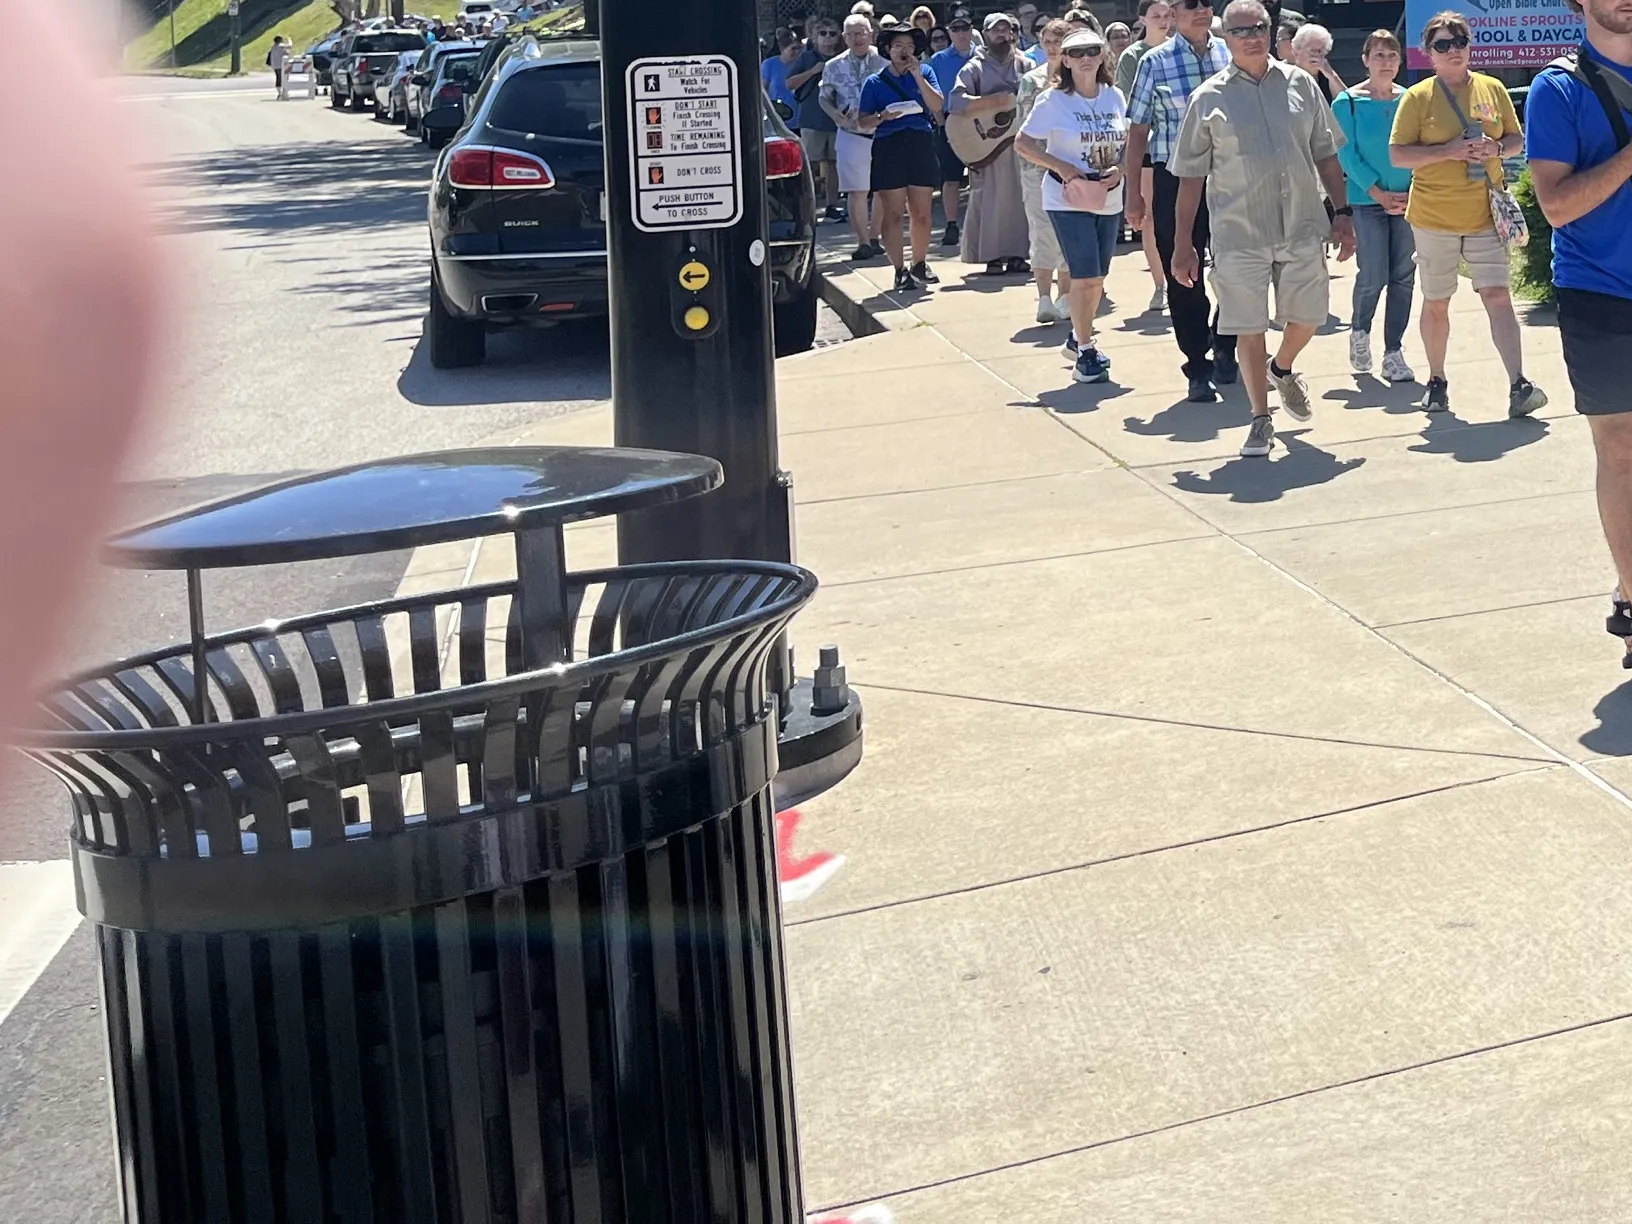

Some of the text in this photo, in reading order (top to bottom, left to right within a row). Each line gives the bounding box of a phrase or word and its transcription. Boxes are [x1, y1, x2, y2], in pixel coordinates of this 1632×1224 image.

[1468, 14, 1583, 28] OKLINE SPROUTS
[1517, 29, 1527, 42] &
[1532, 27, 1586, 42] DAYCA
[1471, 47, 1513, 59] nrolling
[690, 66, 722, 76] CROSSING
[680, 77, 710, 86] Watch For
[684, 86, 708, 94] Vehicles
[675, 100, 717, 110] DON'T START
[673, 111, 721, 120] Finish Crossing
[690, 119, 713, 127] Started
[671, 131, 725, 141] TIME REMAINING
[671, 141, 726, 151] To Finish Crossing
[677, 166, 722, 176] DON'T CROSS
[659, 192, 714, 203] PUSH BUTTON
[667, 207, 708, 217] TO CROSS
